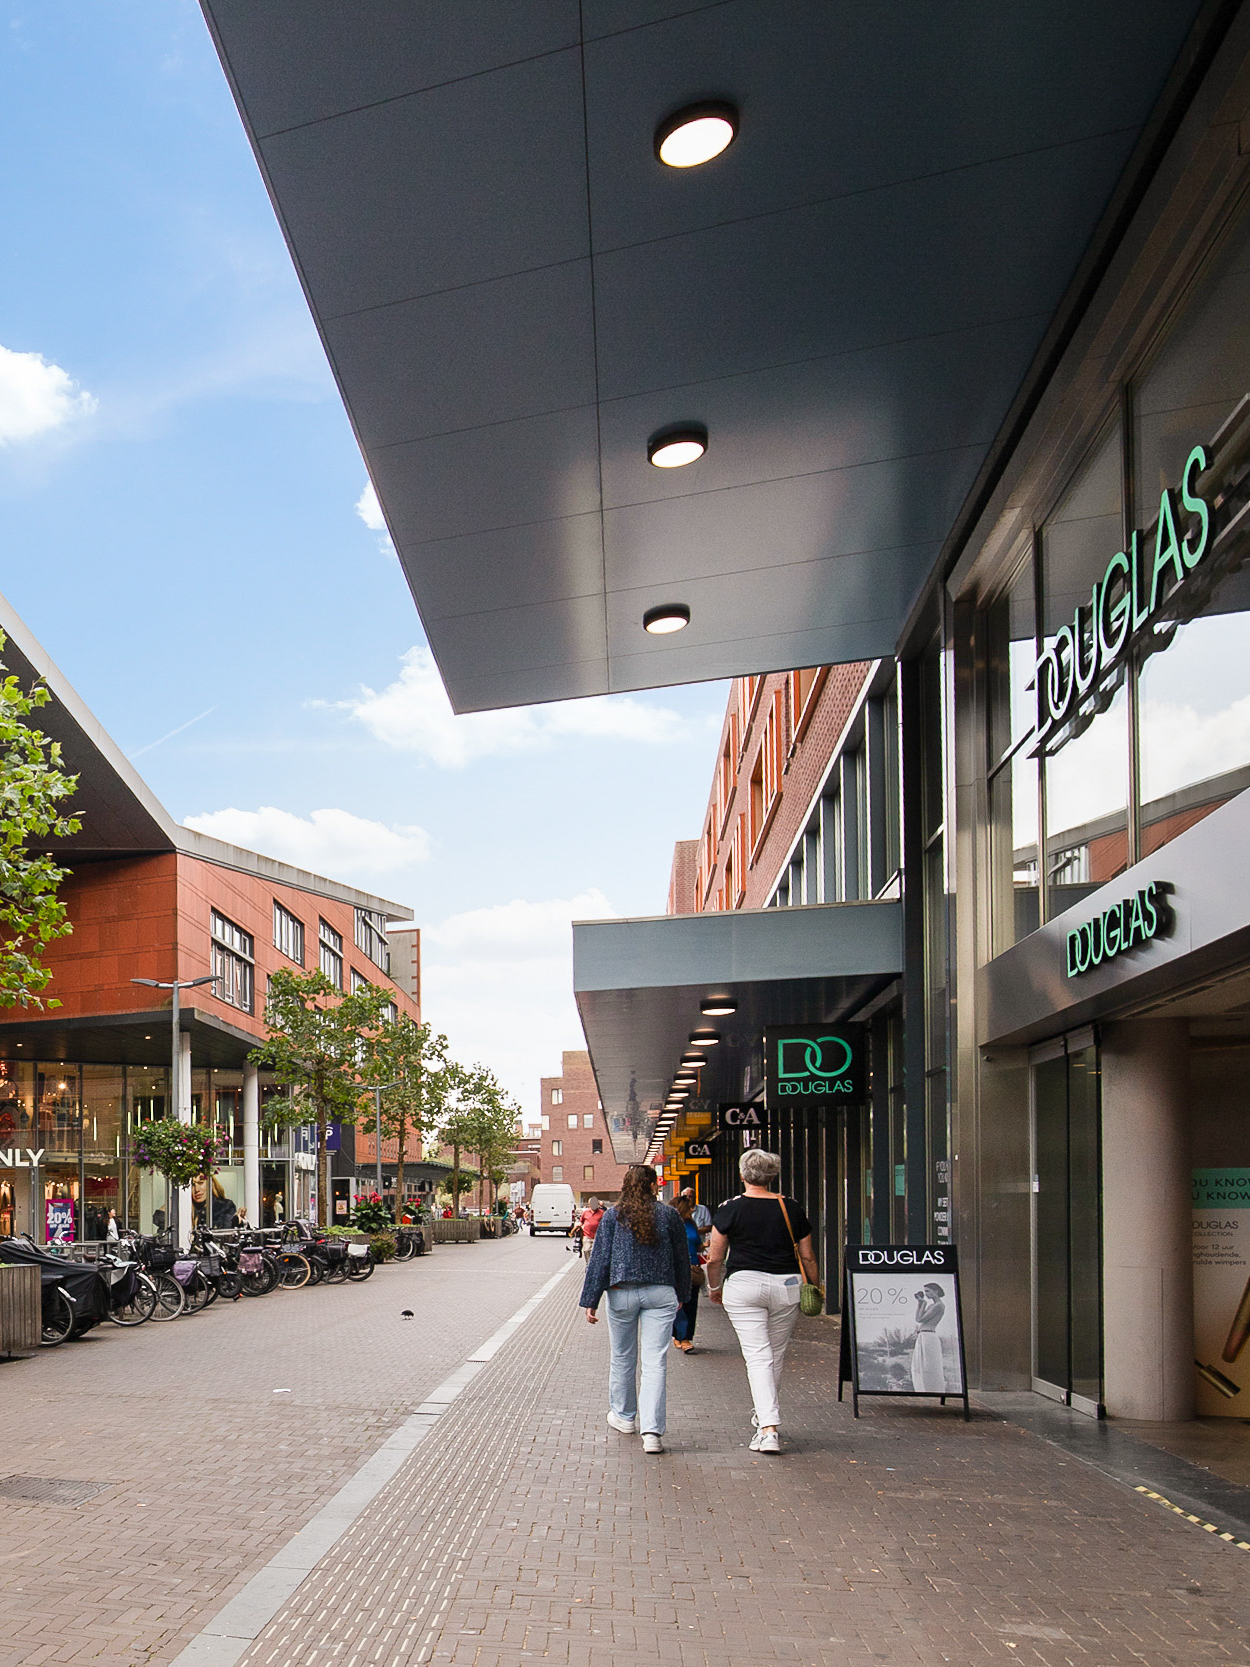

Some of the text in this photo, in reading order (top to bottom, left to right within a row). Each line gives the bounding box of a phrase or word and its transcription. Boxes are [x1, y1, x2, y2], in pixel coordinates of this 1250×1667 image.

[1035, 445, 1209, 742] DOUGLAS
[1066, 881, 1157, 978] DOUGLAS
[777, 1079, 854, 1096] DOUGLAS
[724, 1107, 761, 1126] C&A
[1215, 1177, 1250, 1188] KNO
[47, 1212, 73, 1224] 20%
[858, 1250, 945, 1265] DOUGLAS
[857, 1288, 883, 1305] 20
